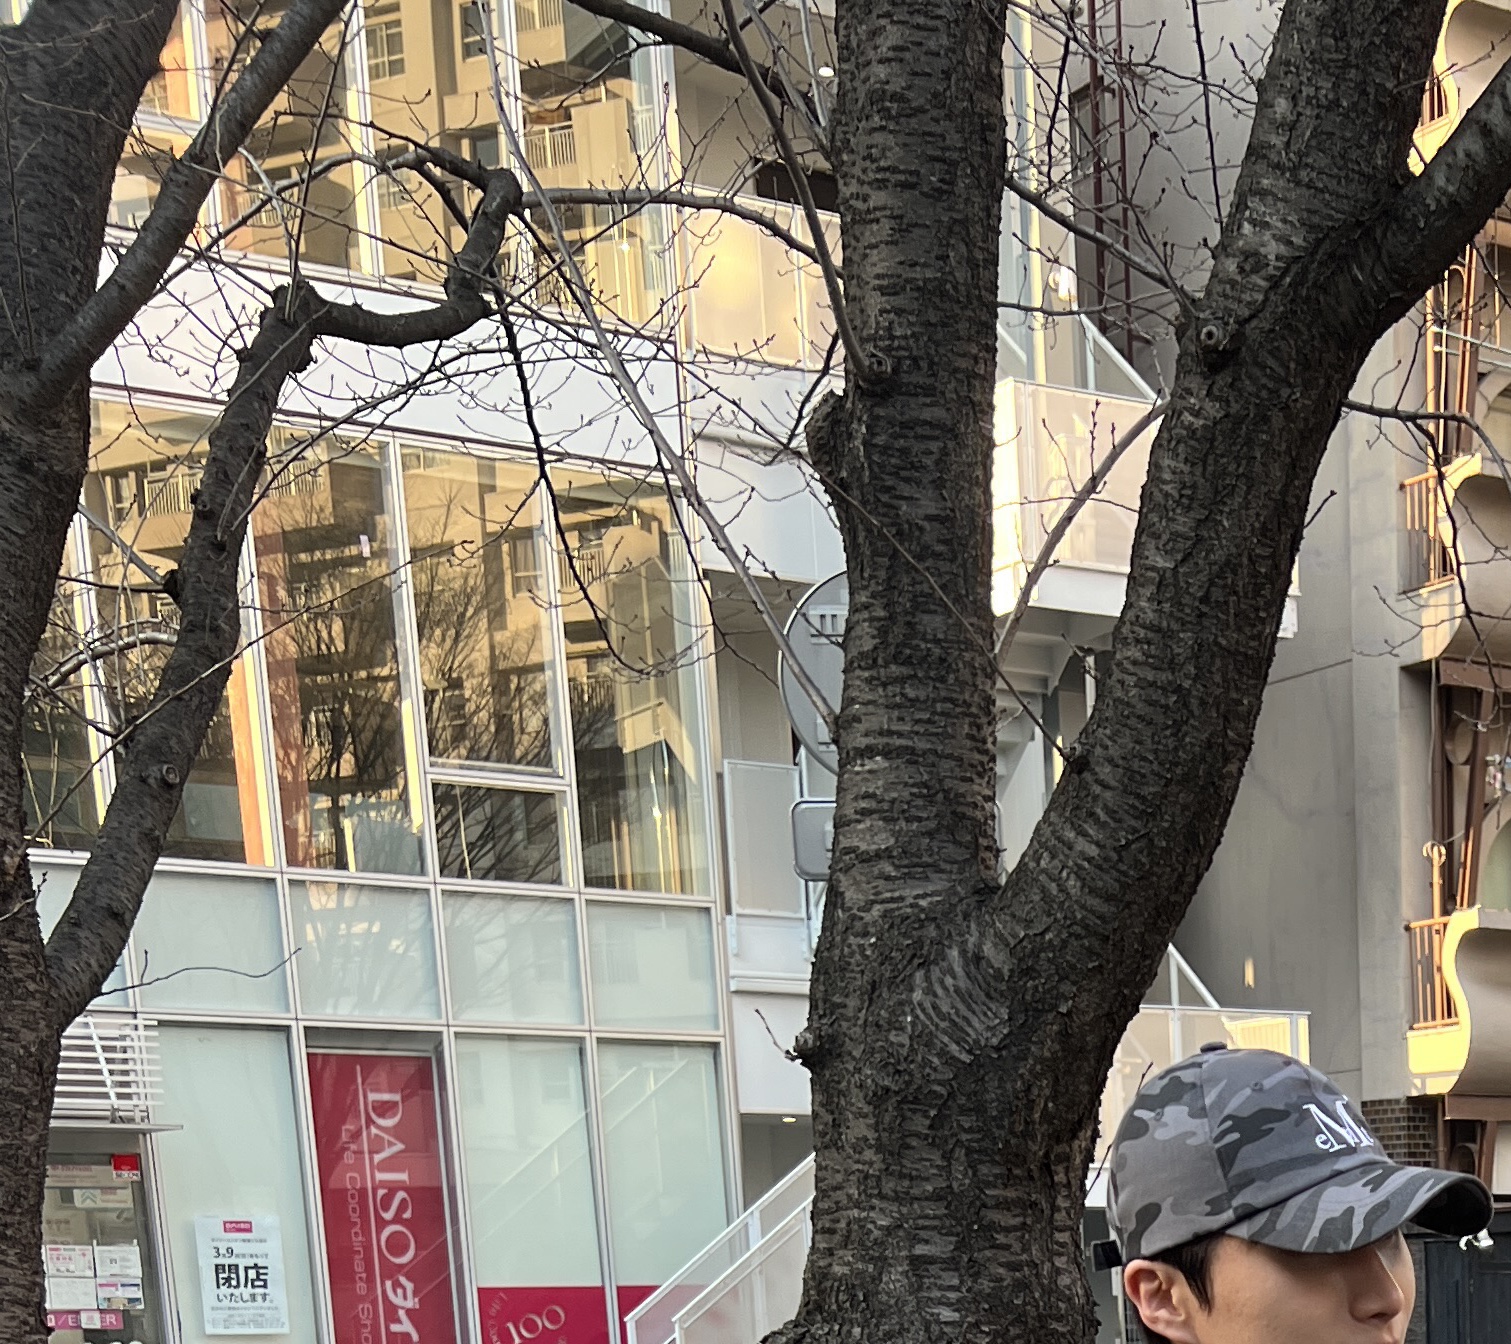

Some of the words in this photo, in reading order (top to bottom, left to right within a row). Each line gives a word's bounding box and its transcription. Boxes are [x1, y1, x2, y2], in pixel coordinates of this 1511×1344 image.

[366, 1091, 416, 1266] DAISO
[346, 1172, 367, 1296] Coordinate
[214, 1263, 269, 1291] 閉店
[216, 1292, 274, 1304] いたします。
[506, 1305, 565, 1344] 100
